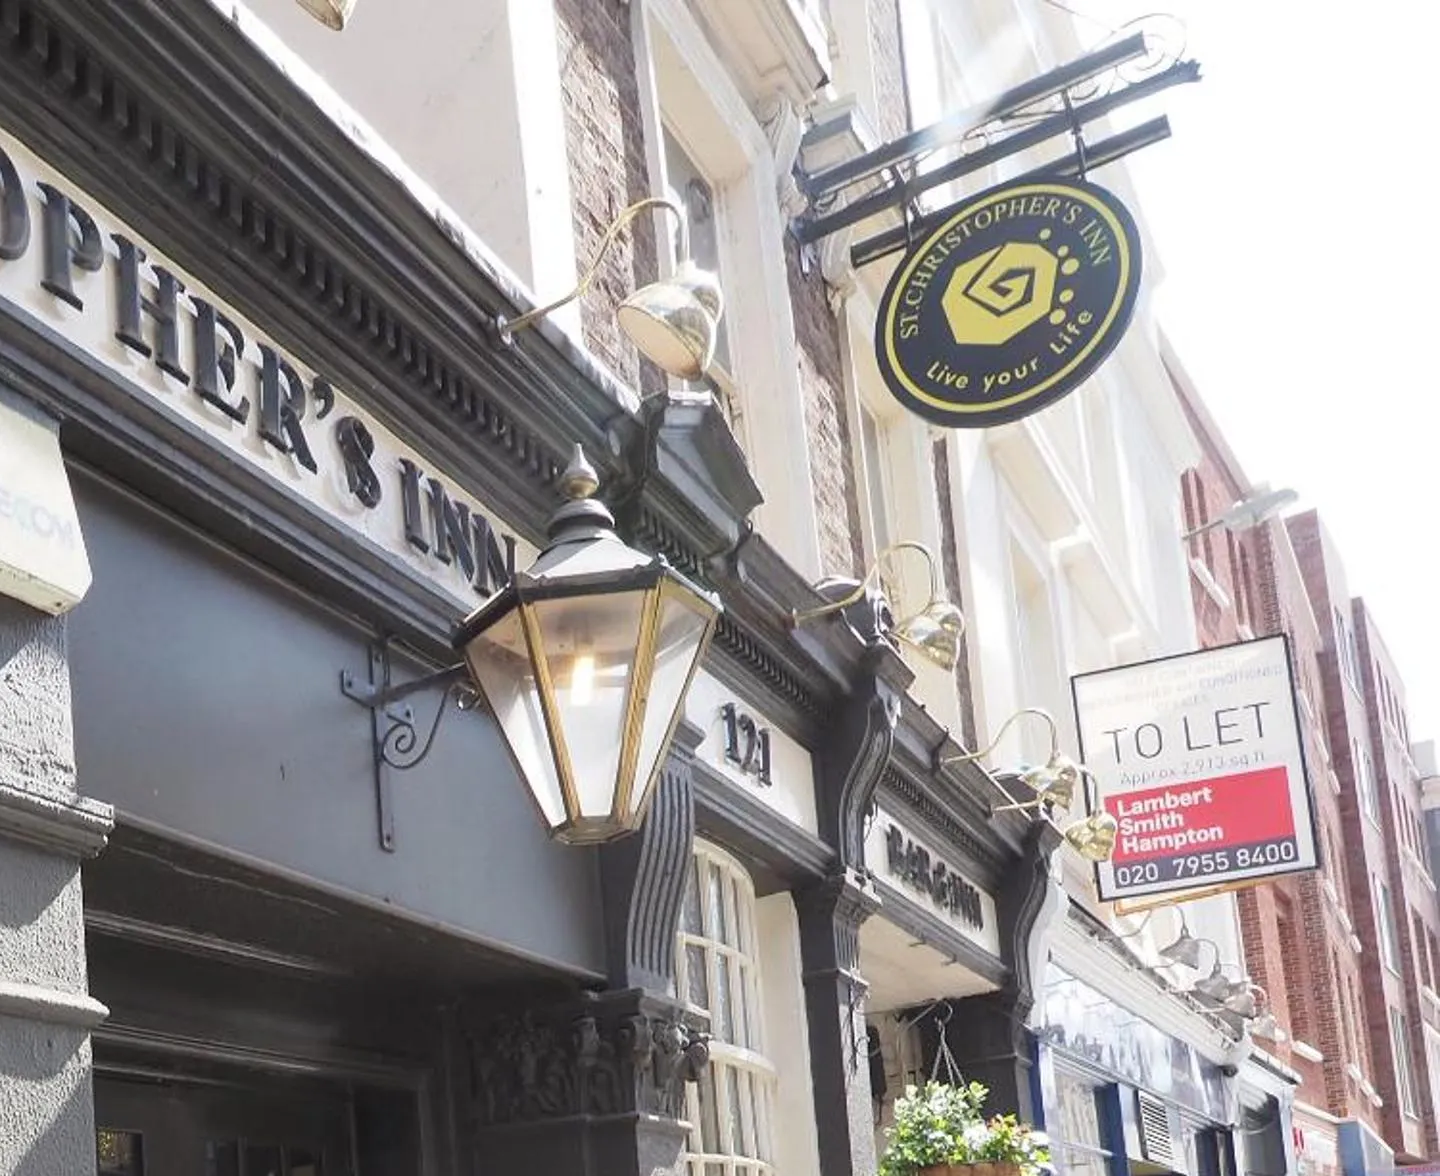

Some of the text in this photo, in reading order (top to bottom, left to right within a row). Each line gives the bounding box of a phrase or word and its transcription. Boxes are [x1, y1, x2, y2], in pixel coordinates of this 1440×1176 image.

[1080, 219, 1112, 267] INN
[926, 308, 1094, 393] Live your Life
[398, 457, 517, 599] INN
[721, 701, 773, 787] 121
[1103, 702, 1271, 764] TO LET
[1117, 786, 1213, 817] Lambert
[1119, 814, 1185, 836] Smith
[1122, 824, 1225, 855] Hampton
[1117, 841, 1295, 887] 020 7955 8400
